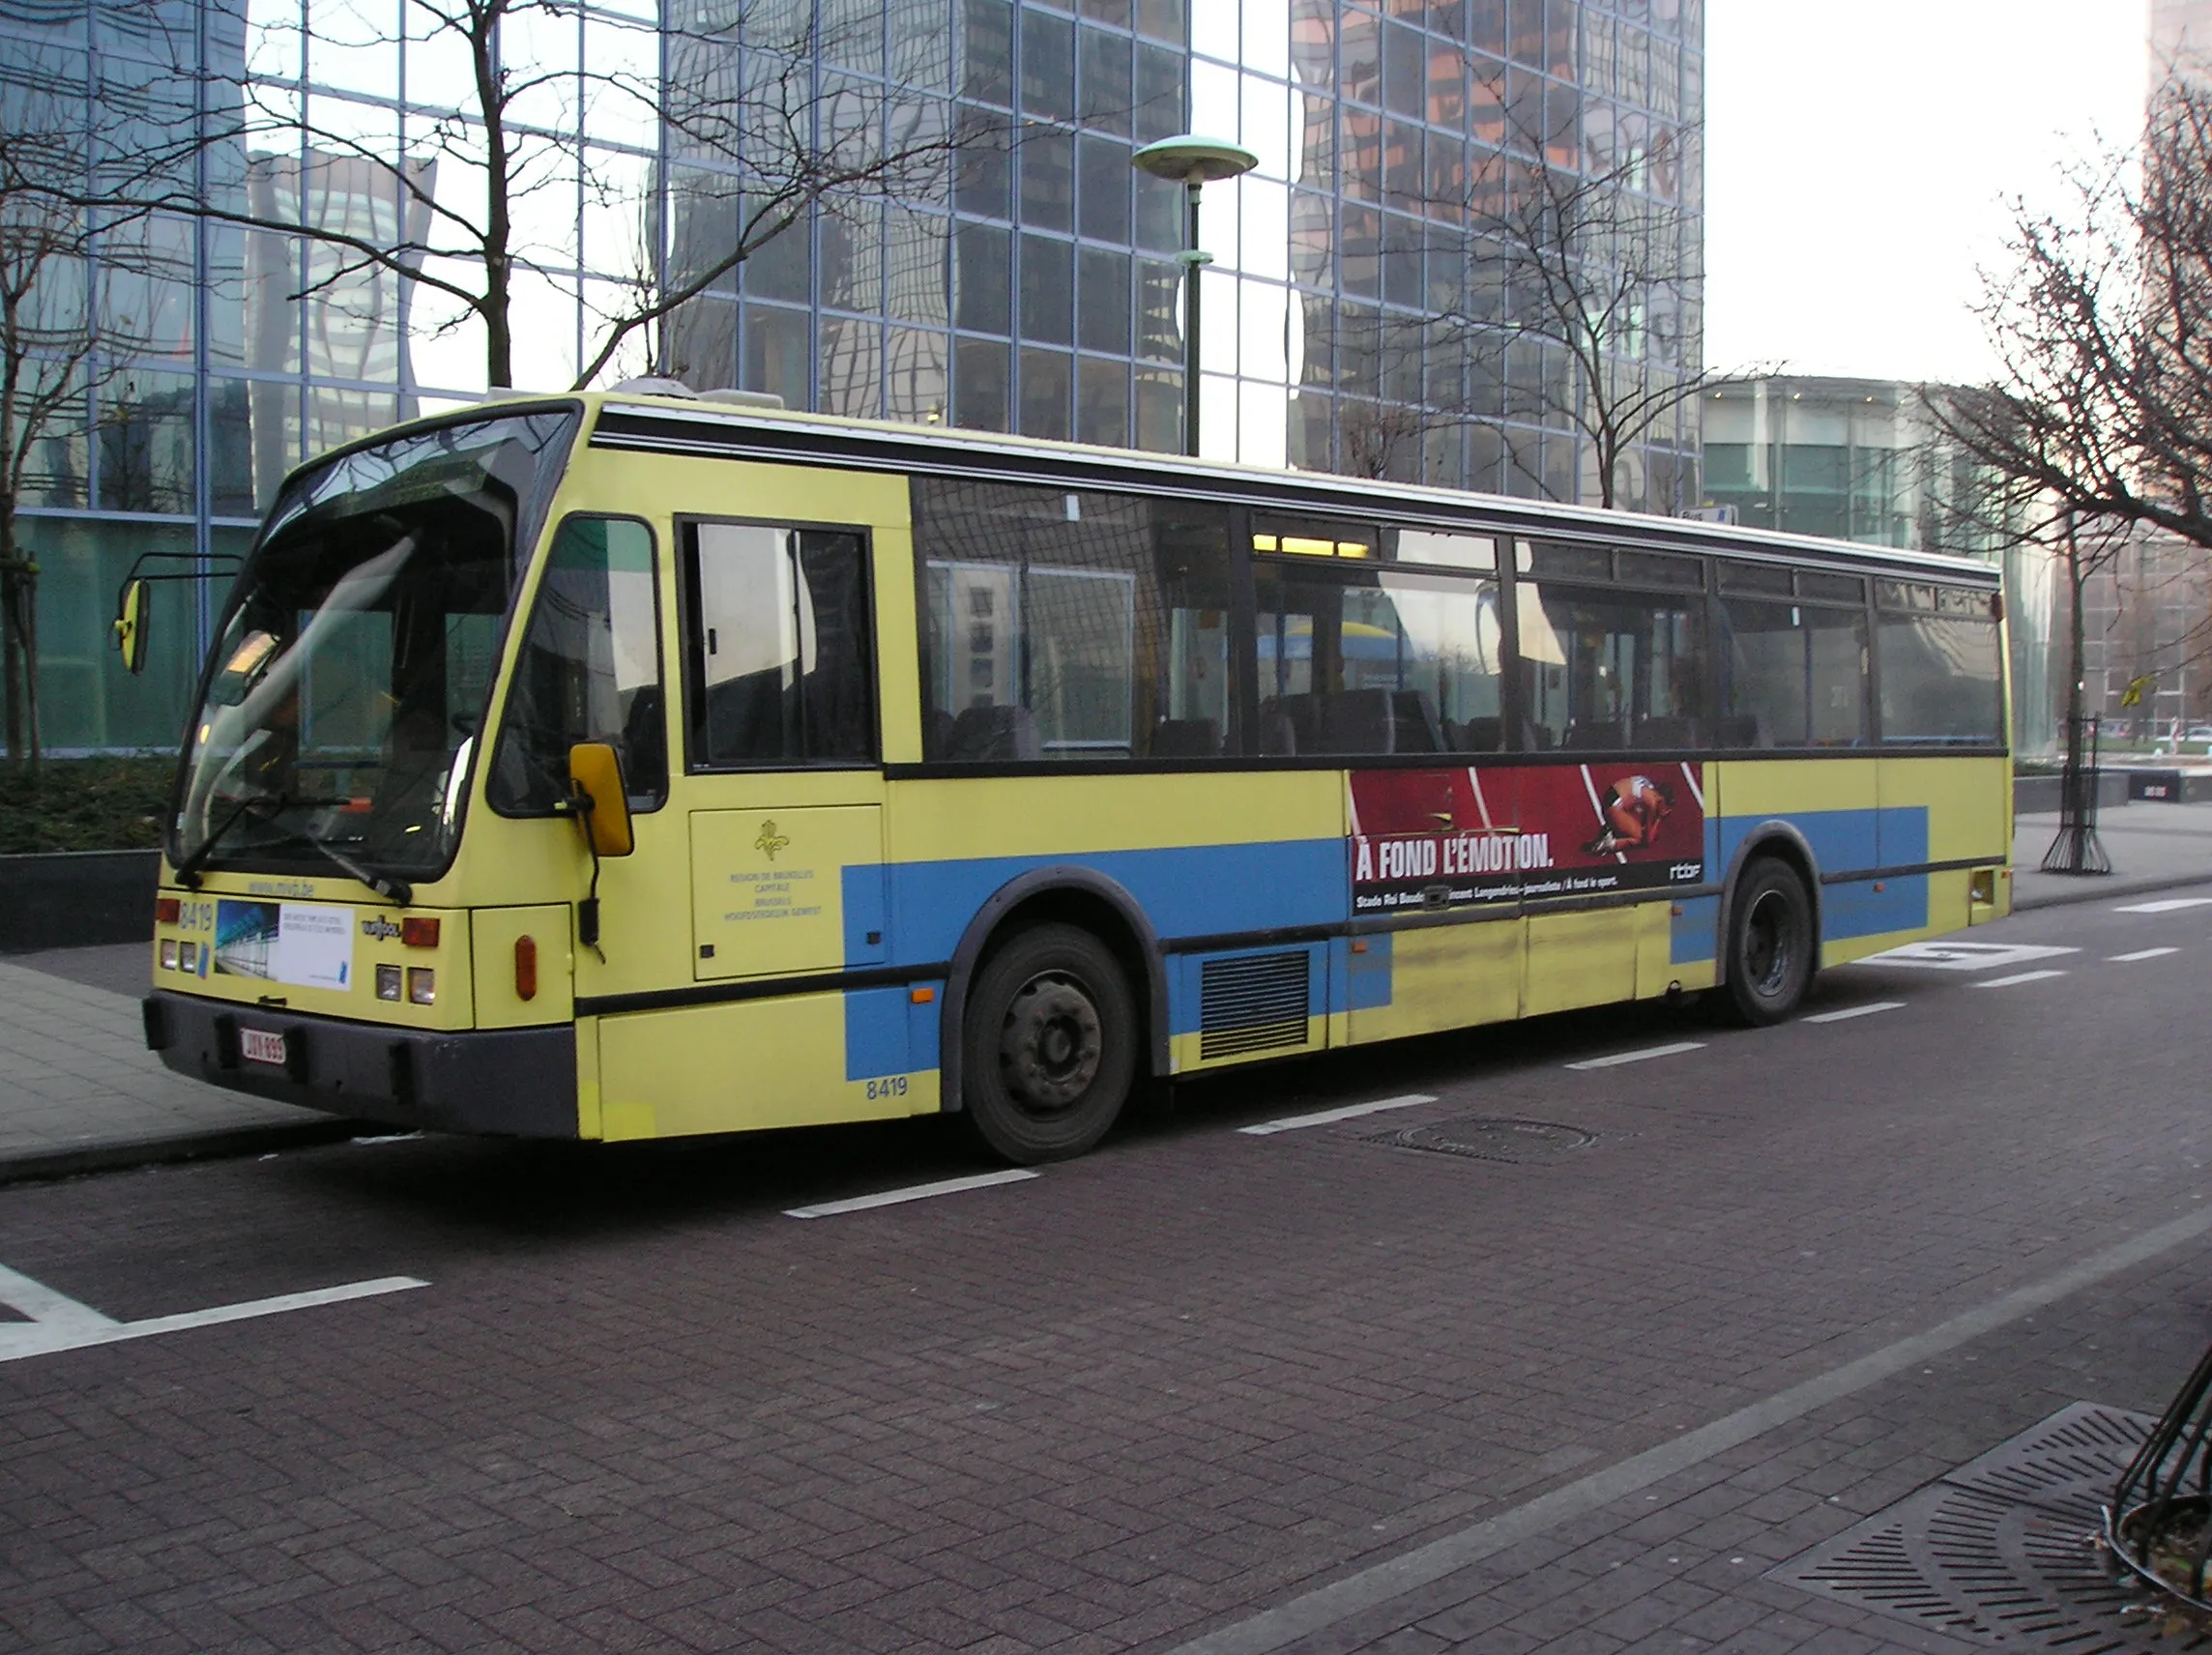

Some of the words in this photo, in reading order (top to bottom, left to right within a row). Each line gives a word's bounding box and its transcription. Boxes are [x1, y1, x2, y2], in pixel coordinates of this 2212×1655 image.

[1355, 834, 1373, 881] À
[1379, 839, 1437, 879] FOND
[1442, 832, 1555, 874] L'ÉMOTION.
[179, 900, 212, 931] 8419
[866, 1076, 908, 1100] 8419
